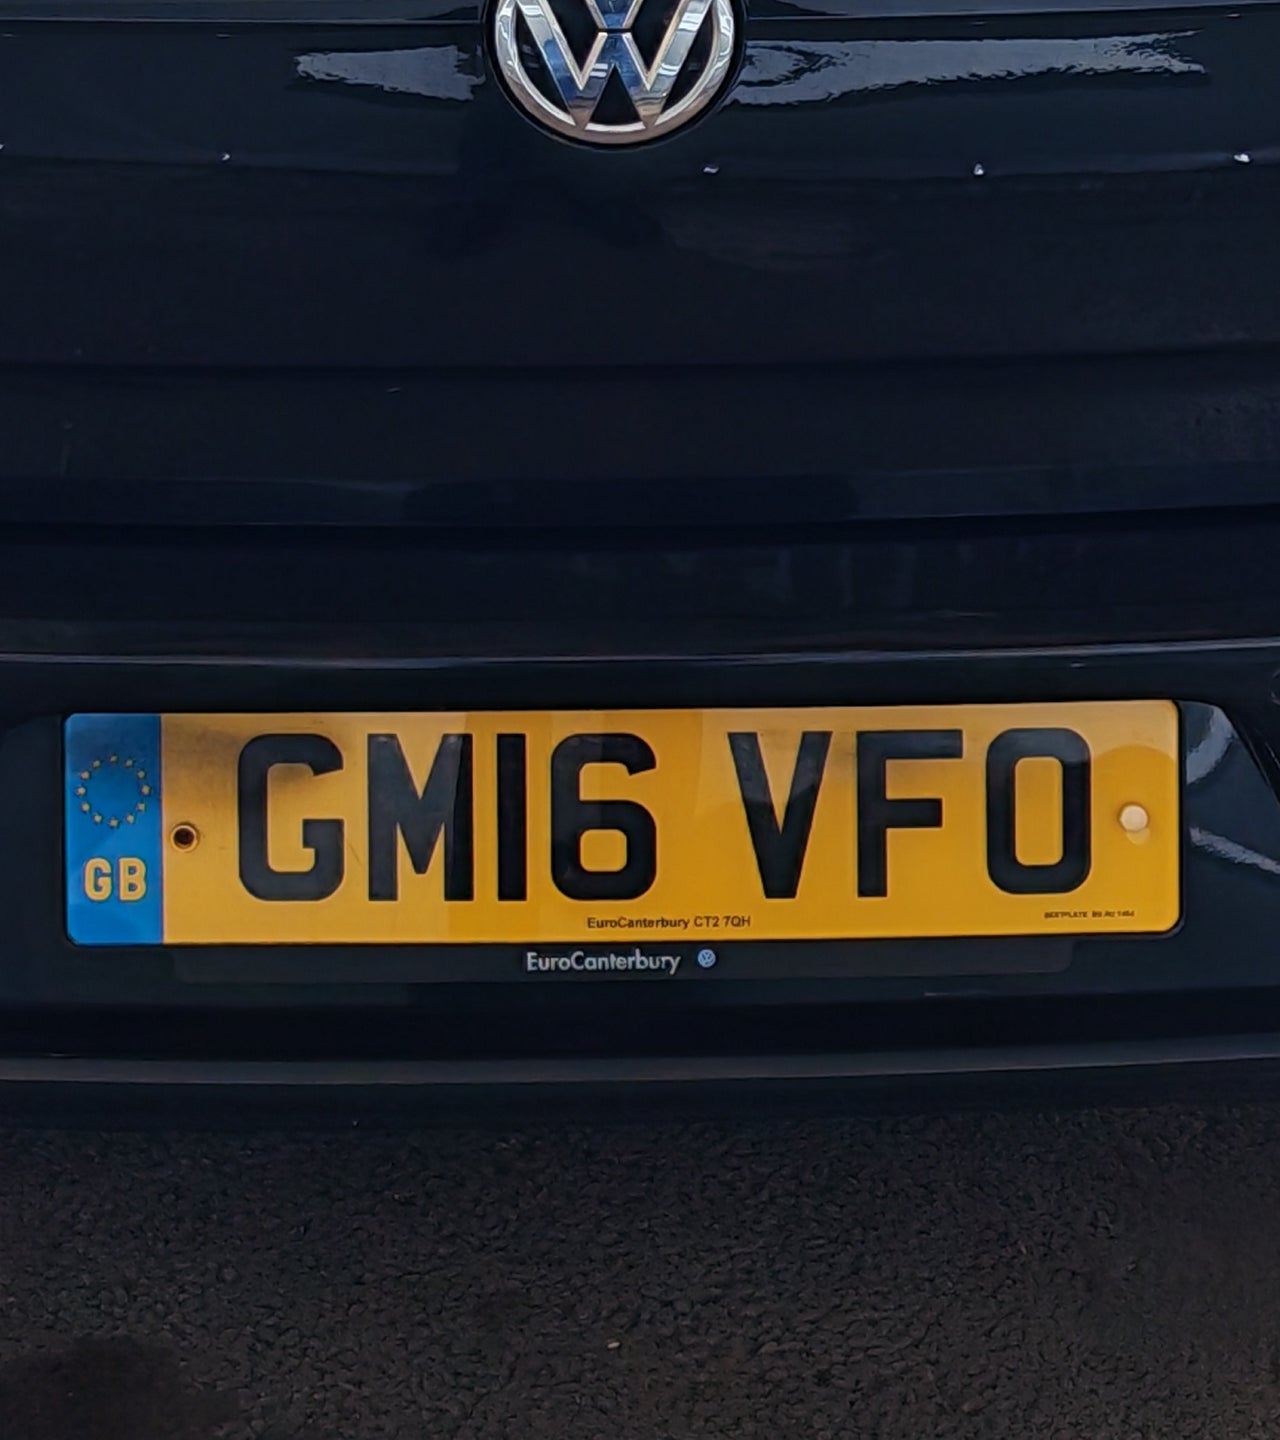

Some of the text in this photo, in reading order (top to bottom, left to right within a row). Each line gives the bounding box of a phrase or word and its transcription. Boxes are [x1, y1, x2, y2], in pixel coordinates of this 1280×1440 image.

[237, 727, 1092, 901] GM16 VFO
[84, 857, 147, 901] GB
[587, 916, 751, 930] EuroCanterbury CT2 7QH
[526, 948, 681, 975] EuroCanterbury
